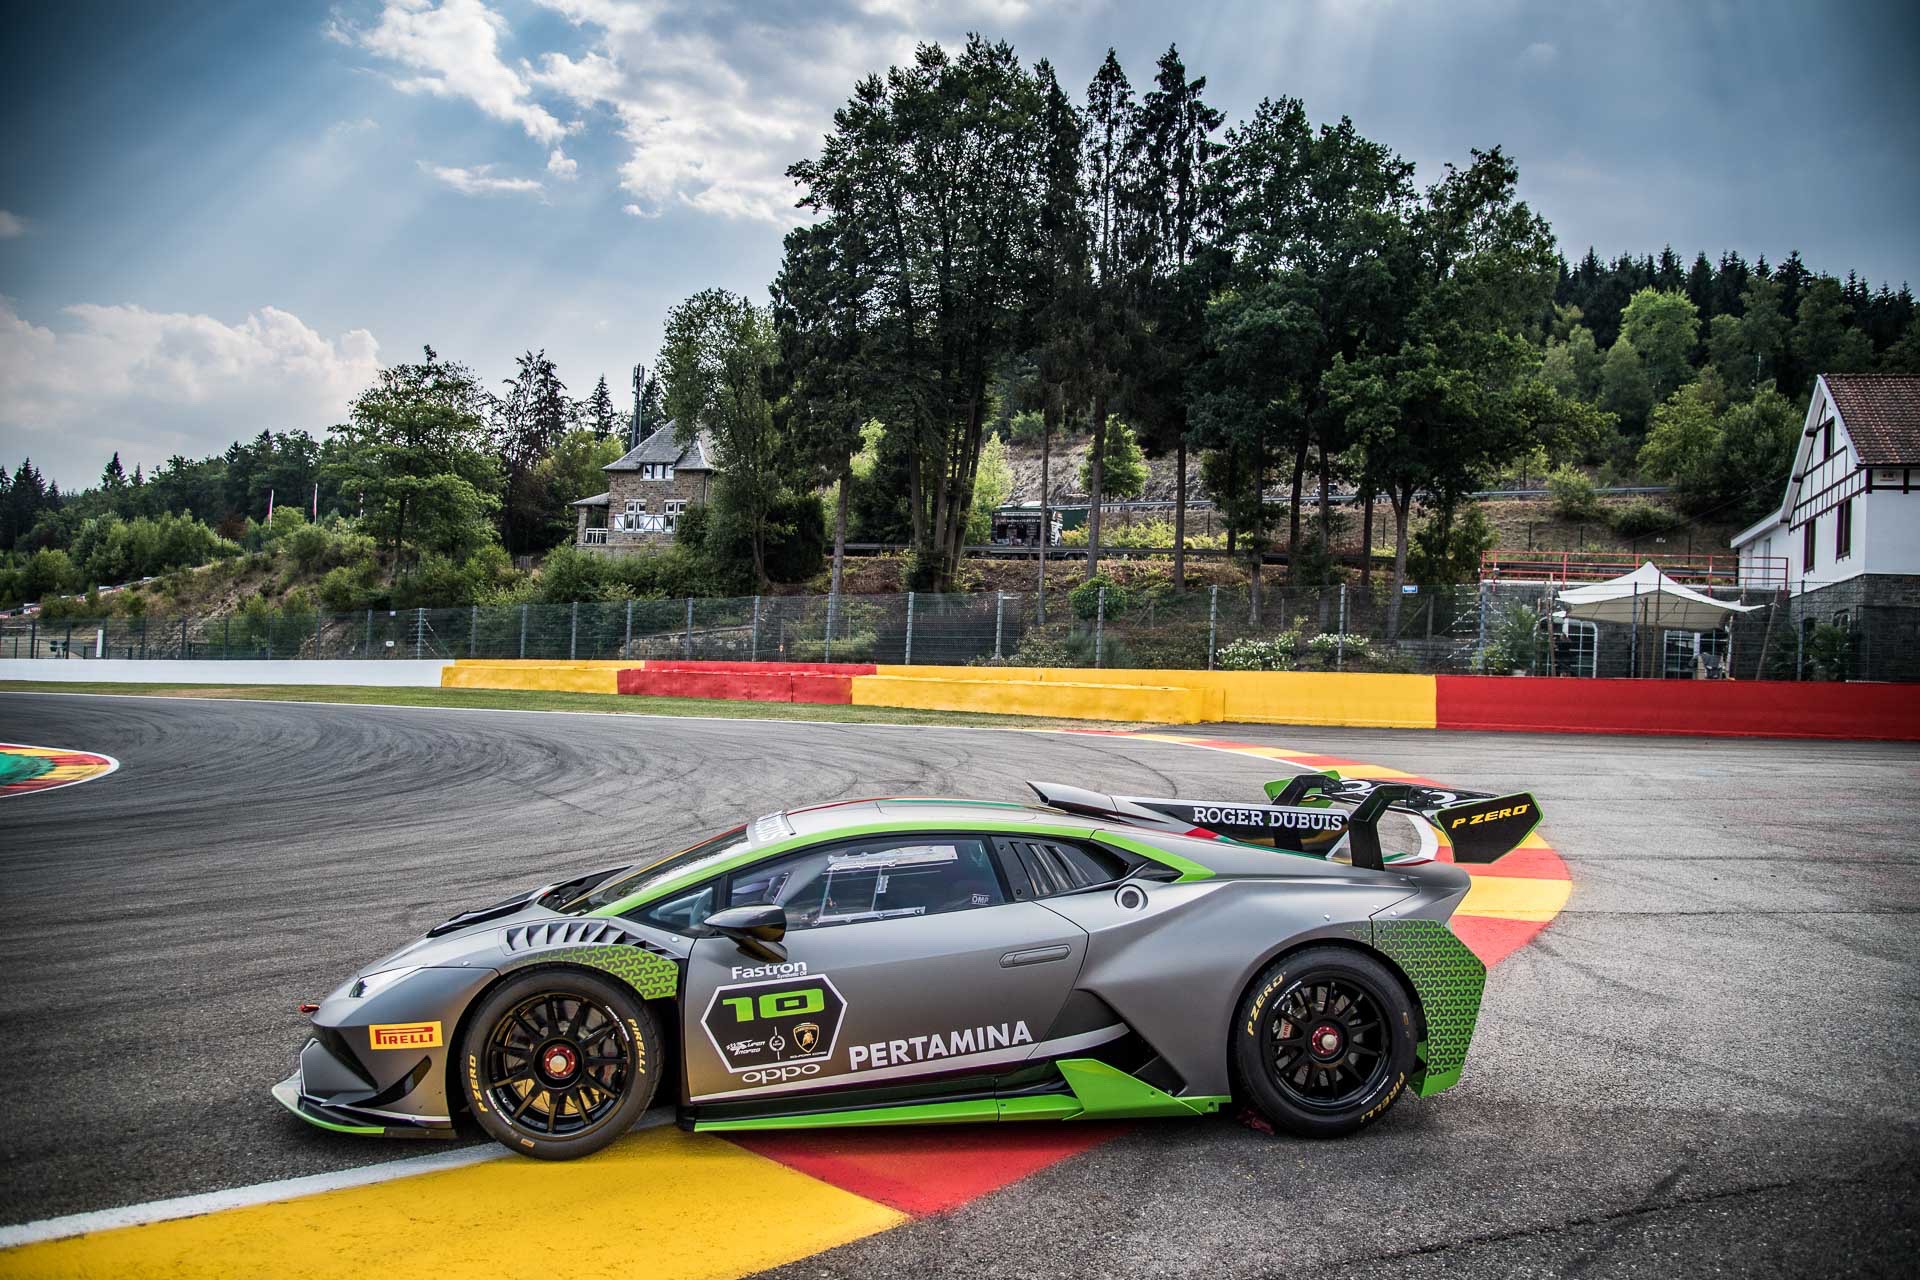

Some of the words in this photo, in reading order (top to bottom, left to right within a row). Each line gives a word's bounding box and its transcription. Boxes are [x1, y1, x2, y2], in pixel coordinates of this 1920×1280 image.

[1193, 807, 1264, 826] ROGER
[1269, 811, 1343, 831] DUBUIS
[1451, 817, 1467, 829] P
[1469, 804, 1528, 825] ZERO
[731, 961, 808, 980] Fastron
[722, 988, 825, 1023] 10
[1250, 974, 1285, 1021] ZERO
[375, 1026, 433, 1045] PIRELLI
[1247, 1021, 1254, 1036] P
[627, 1018, 645, 1074] PIRELLI
[848, 1020, 1033, 1071] PERTAMINA
[468, 1054, 484, 1101] ZERO
[742, 1063, 821, 1084] oppo
